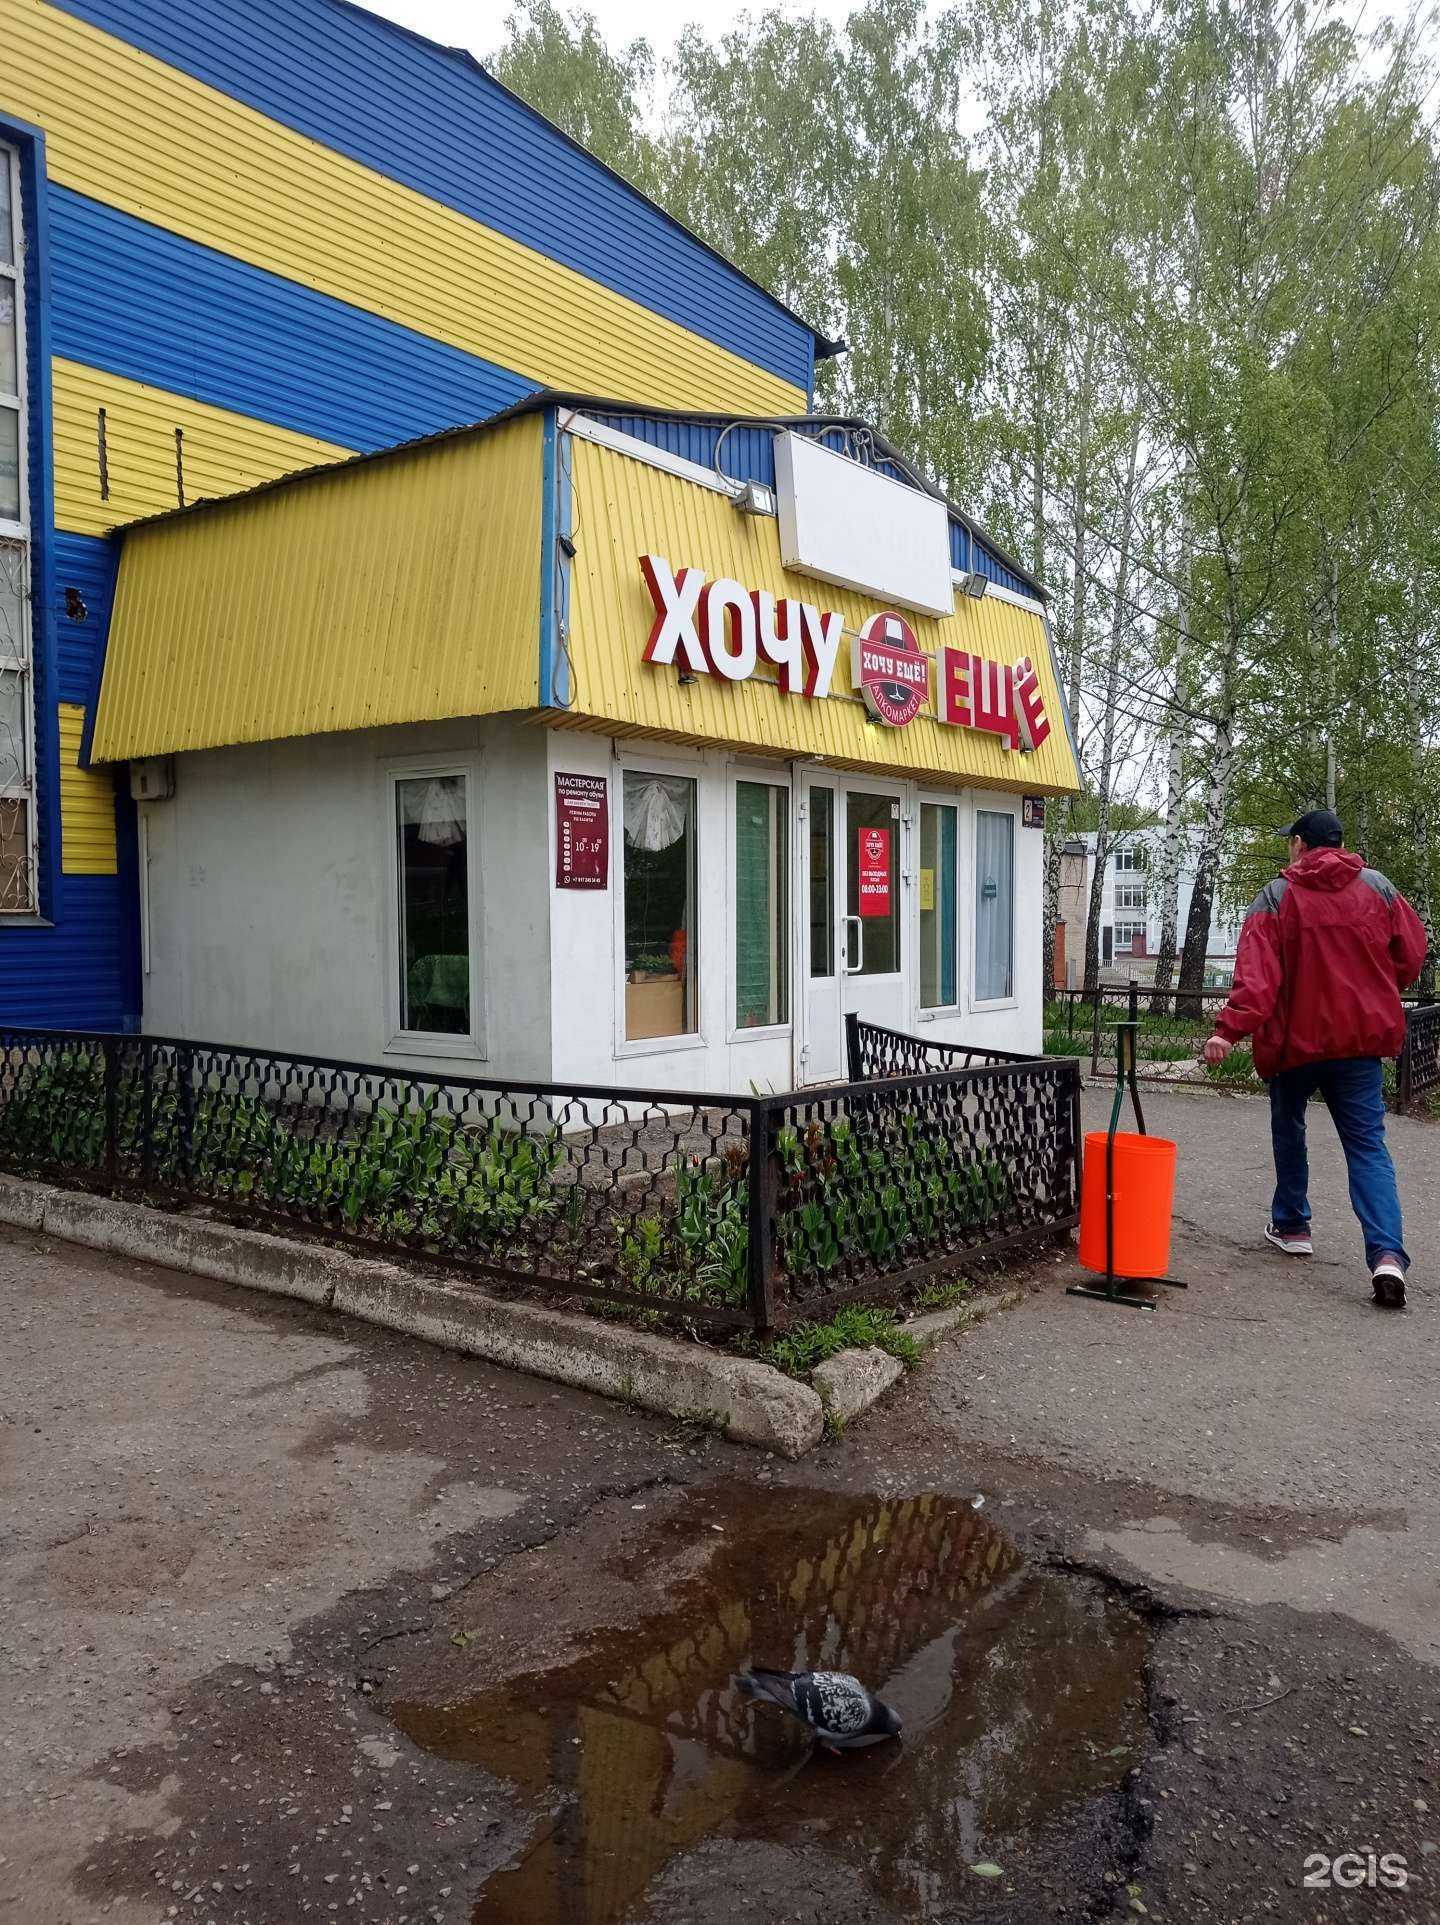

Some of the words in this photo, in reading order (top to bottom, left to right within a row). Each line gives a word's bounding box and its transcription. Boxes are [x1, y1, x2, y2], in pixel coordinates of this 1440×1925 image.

[638, 554, 845, 699] ХОЧУ
[940, 646, 1051, 751] ЕЩЁ
[863, 651, 894, 675] ХОЧУ
[896, 661, 926, 683] ЕЩЁ!
[872, 684, 919, 723] АЛКОМАРКЕТ
[557, 775, 605, 791] МАСТЕРСКАЯ
[566, 789, 588, 798] ремонту
[589, 791, 605, 799] обуви
[576, 841, 585, 852] 10
[591, 842, 600, 853] 19
